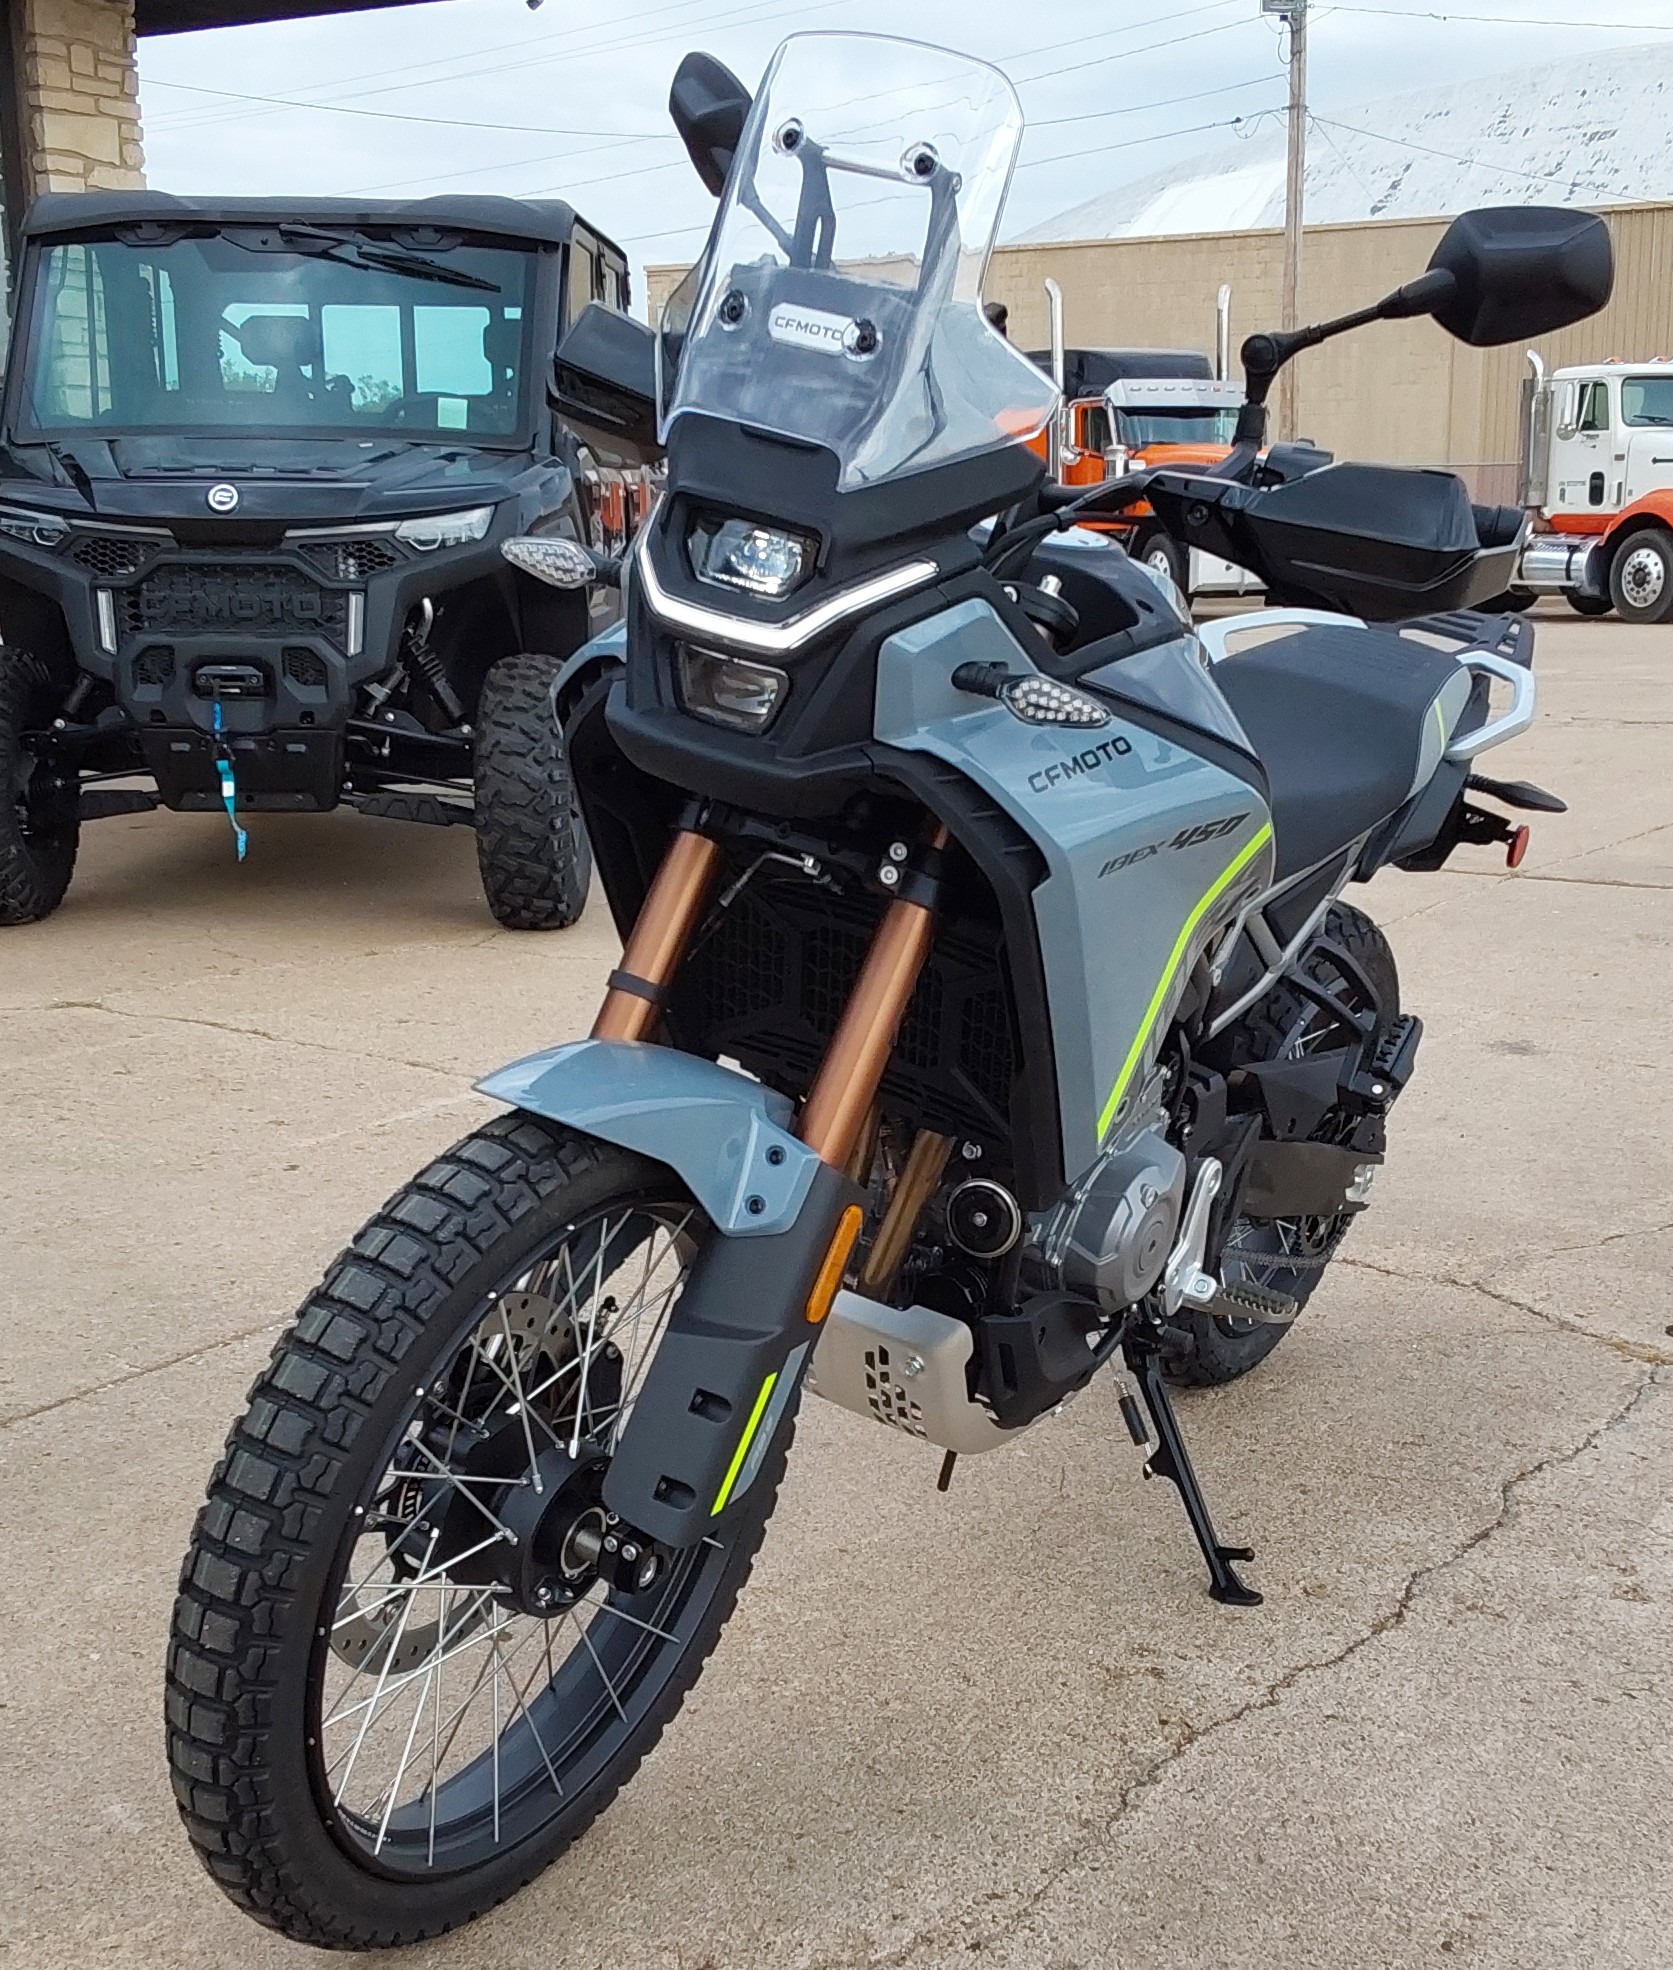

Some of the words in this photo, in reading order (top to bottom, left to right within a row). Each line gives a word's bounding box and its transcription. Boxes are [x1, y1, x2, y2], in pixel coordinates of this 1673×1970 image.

[774, 316, 842, 341] CFMOTO
[140, 591, 321, 619] CFMOTO
[1027, 736, 1132, 793] CFMOTO
[1097, 840, 1167, 879] IBEX
[1168, 812, 1251, 851] 450
